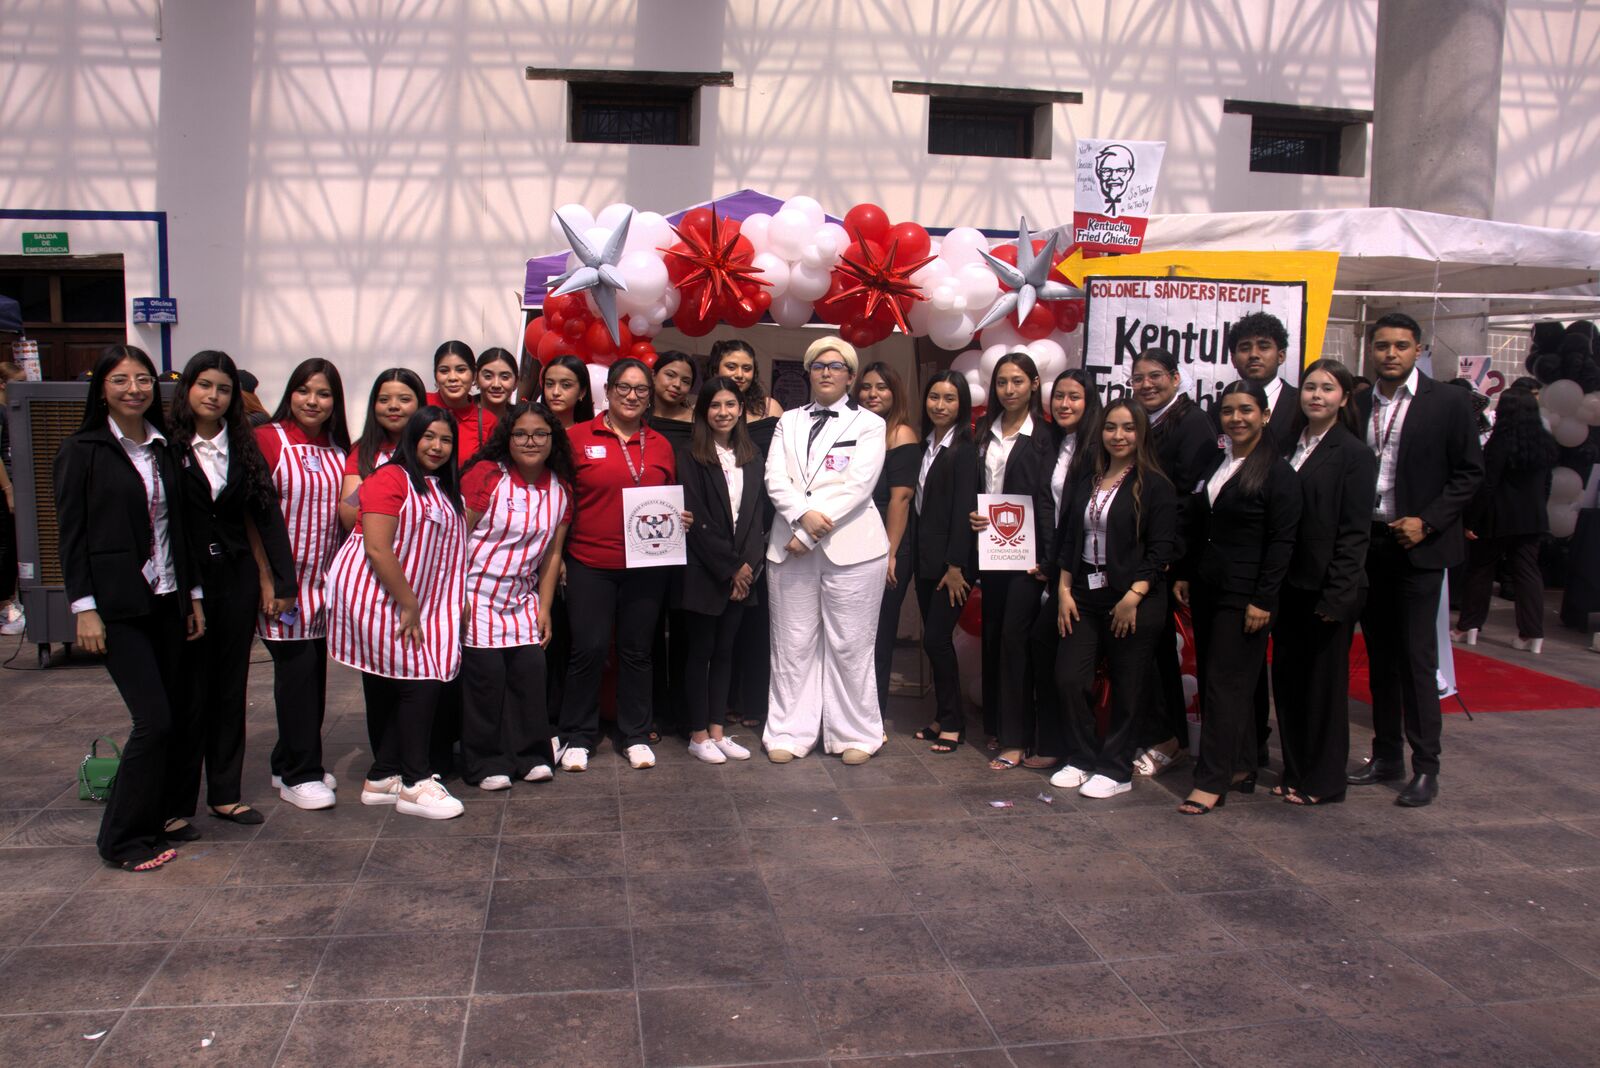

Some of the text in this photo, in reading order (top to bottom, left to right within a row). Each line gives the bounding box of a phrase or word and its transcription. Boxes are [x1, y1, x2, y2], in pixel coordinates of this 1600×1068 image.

[1088, 219, 1130, 233] Kentucky
[1076, 229, 1139, 245] Fried Chicken
[1091, 282, 1271, 304] COLONEL SANDERS RECIPE
